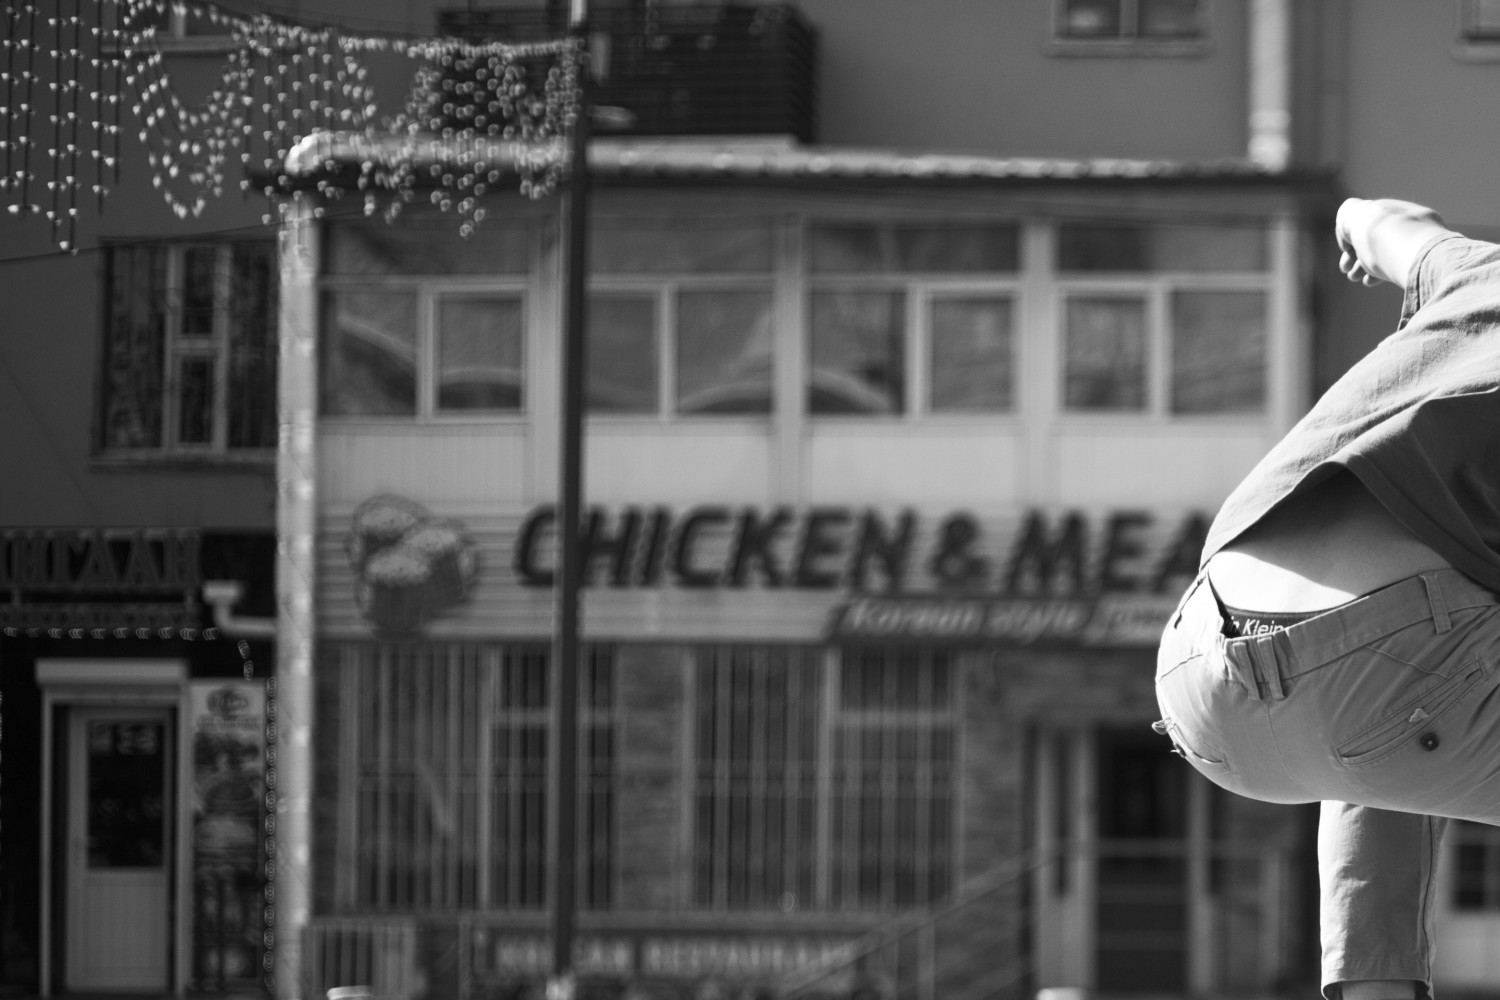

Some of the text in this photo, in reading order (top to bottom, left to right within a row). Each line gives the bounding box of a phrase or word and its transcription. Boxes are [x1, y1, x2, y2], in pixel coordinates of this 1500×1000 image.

[513, 504, 917, 595] CHICKEN
[930, 511, 990, 584] &
[845, 598, 983, 634] Korean
[496, 938, 633, 974] KOEAN
